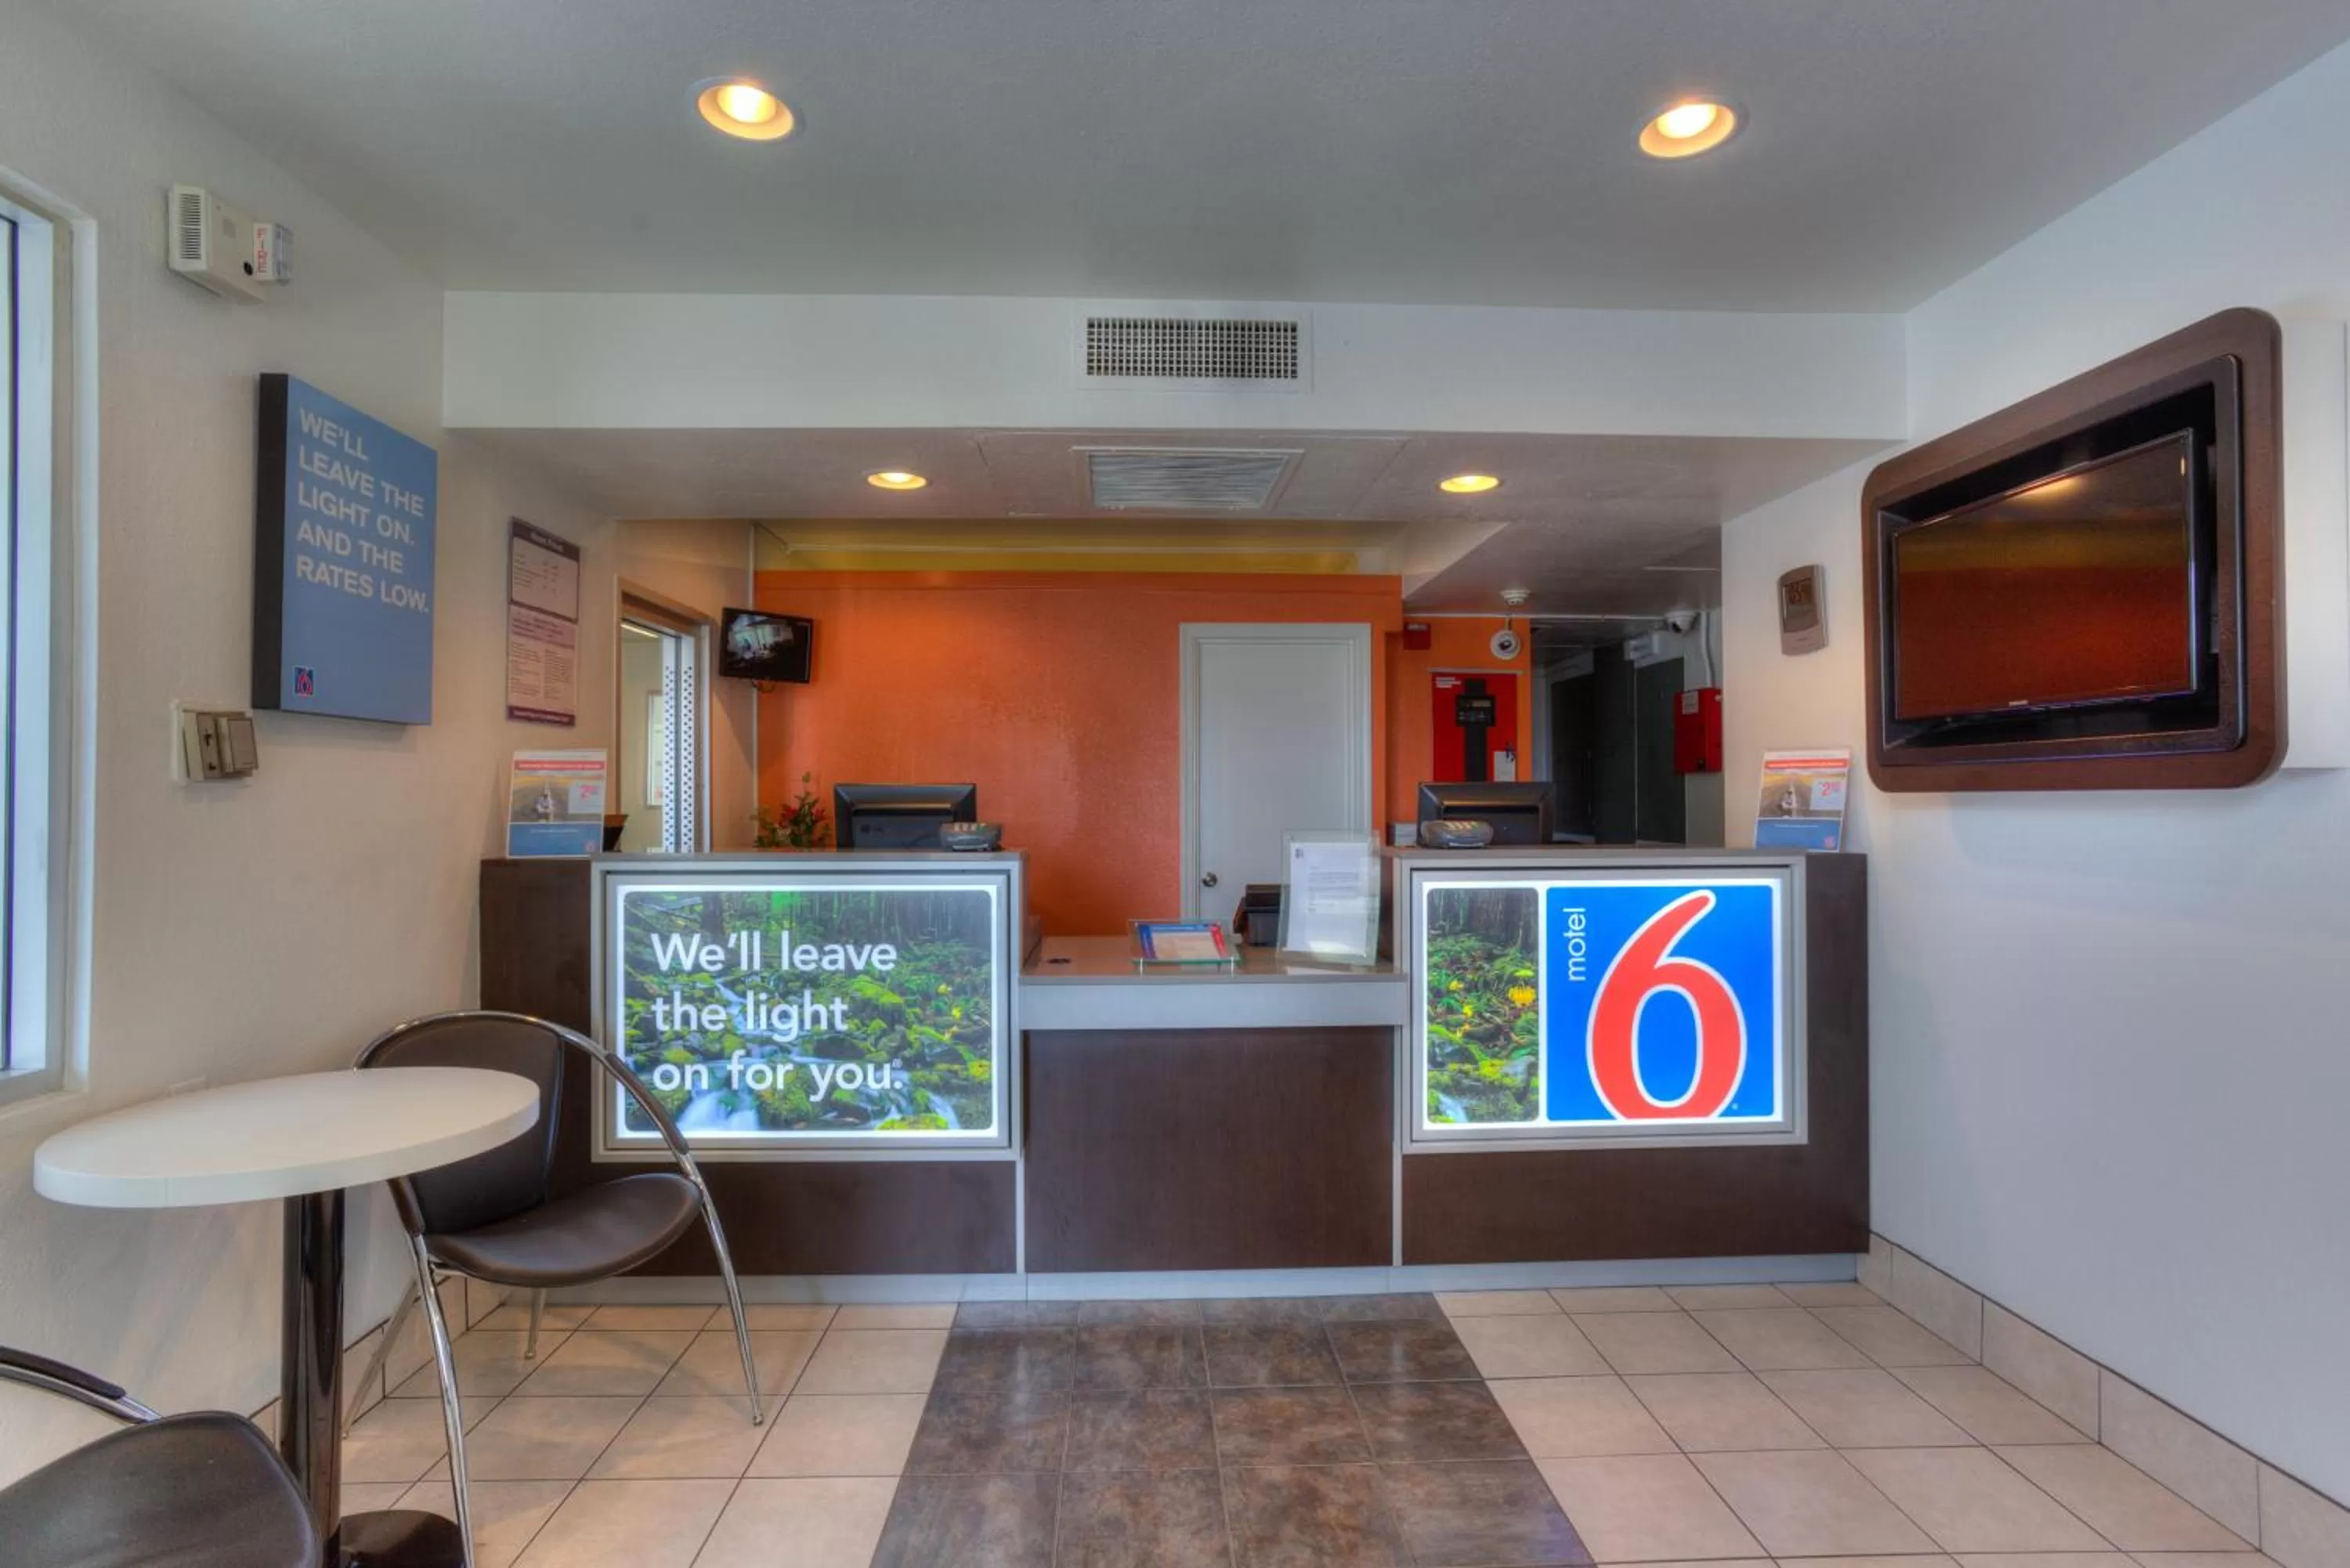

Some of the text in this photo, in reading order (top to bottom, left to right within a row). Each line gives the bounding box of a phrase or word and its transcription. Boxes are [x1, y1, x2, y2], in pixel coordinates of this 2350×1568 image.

[258, 228, 268, 273] FIRE
[300, 406, 368, 461] WE'LL
[298, 444, 425, 518] LEAVE THE
[298, 481, 414, 546] LIGHT ON.
[296, 519, 404, 575] AND THE
[295, 554, 430, 613] RATES LOW.
[651, 930, 898, 972] We'll leave
[1561, 906, 1587, 982] motel
[652, 989, 849, 1042] the light
[1586, 889, 1748, 1120] 6
[652, 1061, 709, 1091] on
[726, 1049, 794, 1089] for
